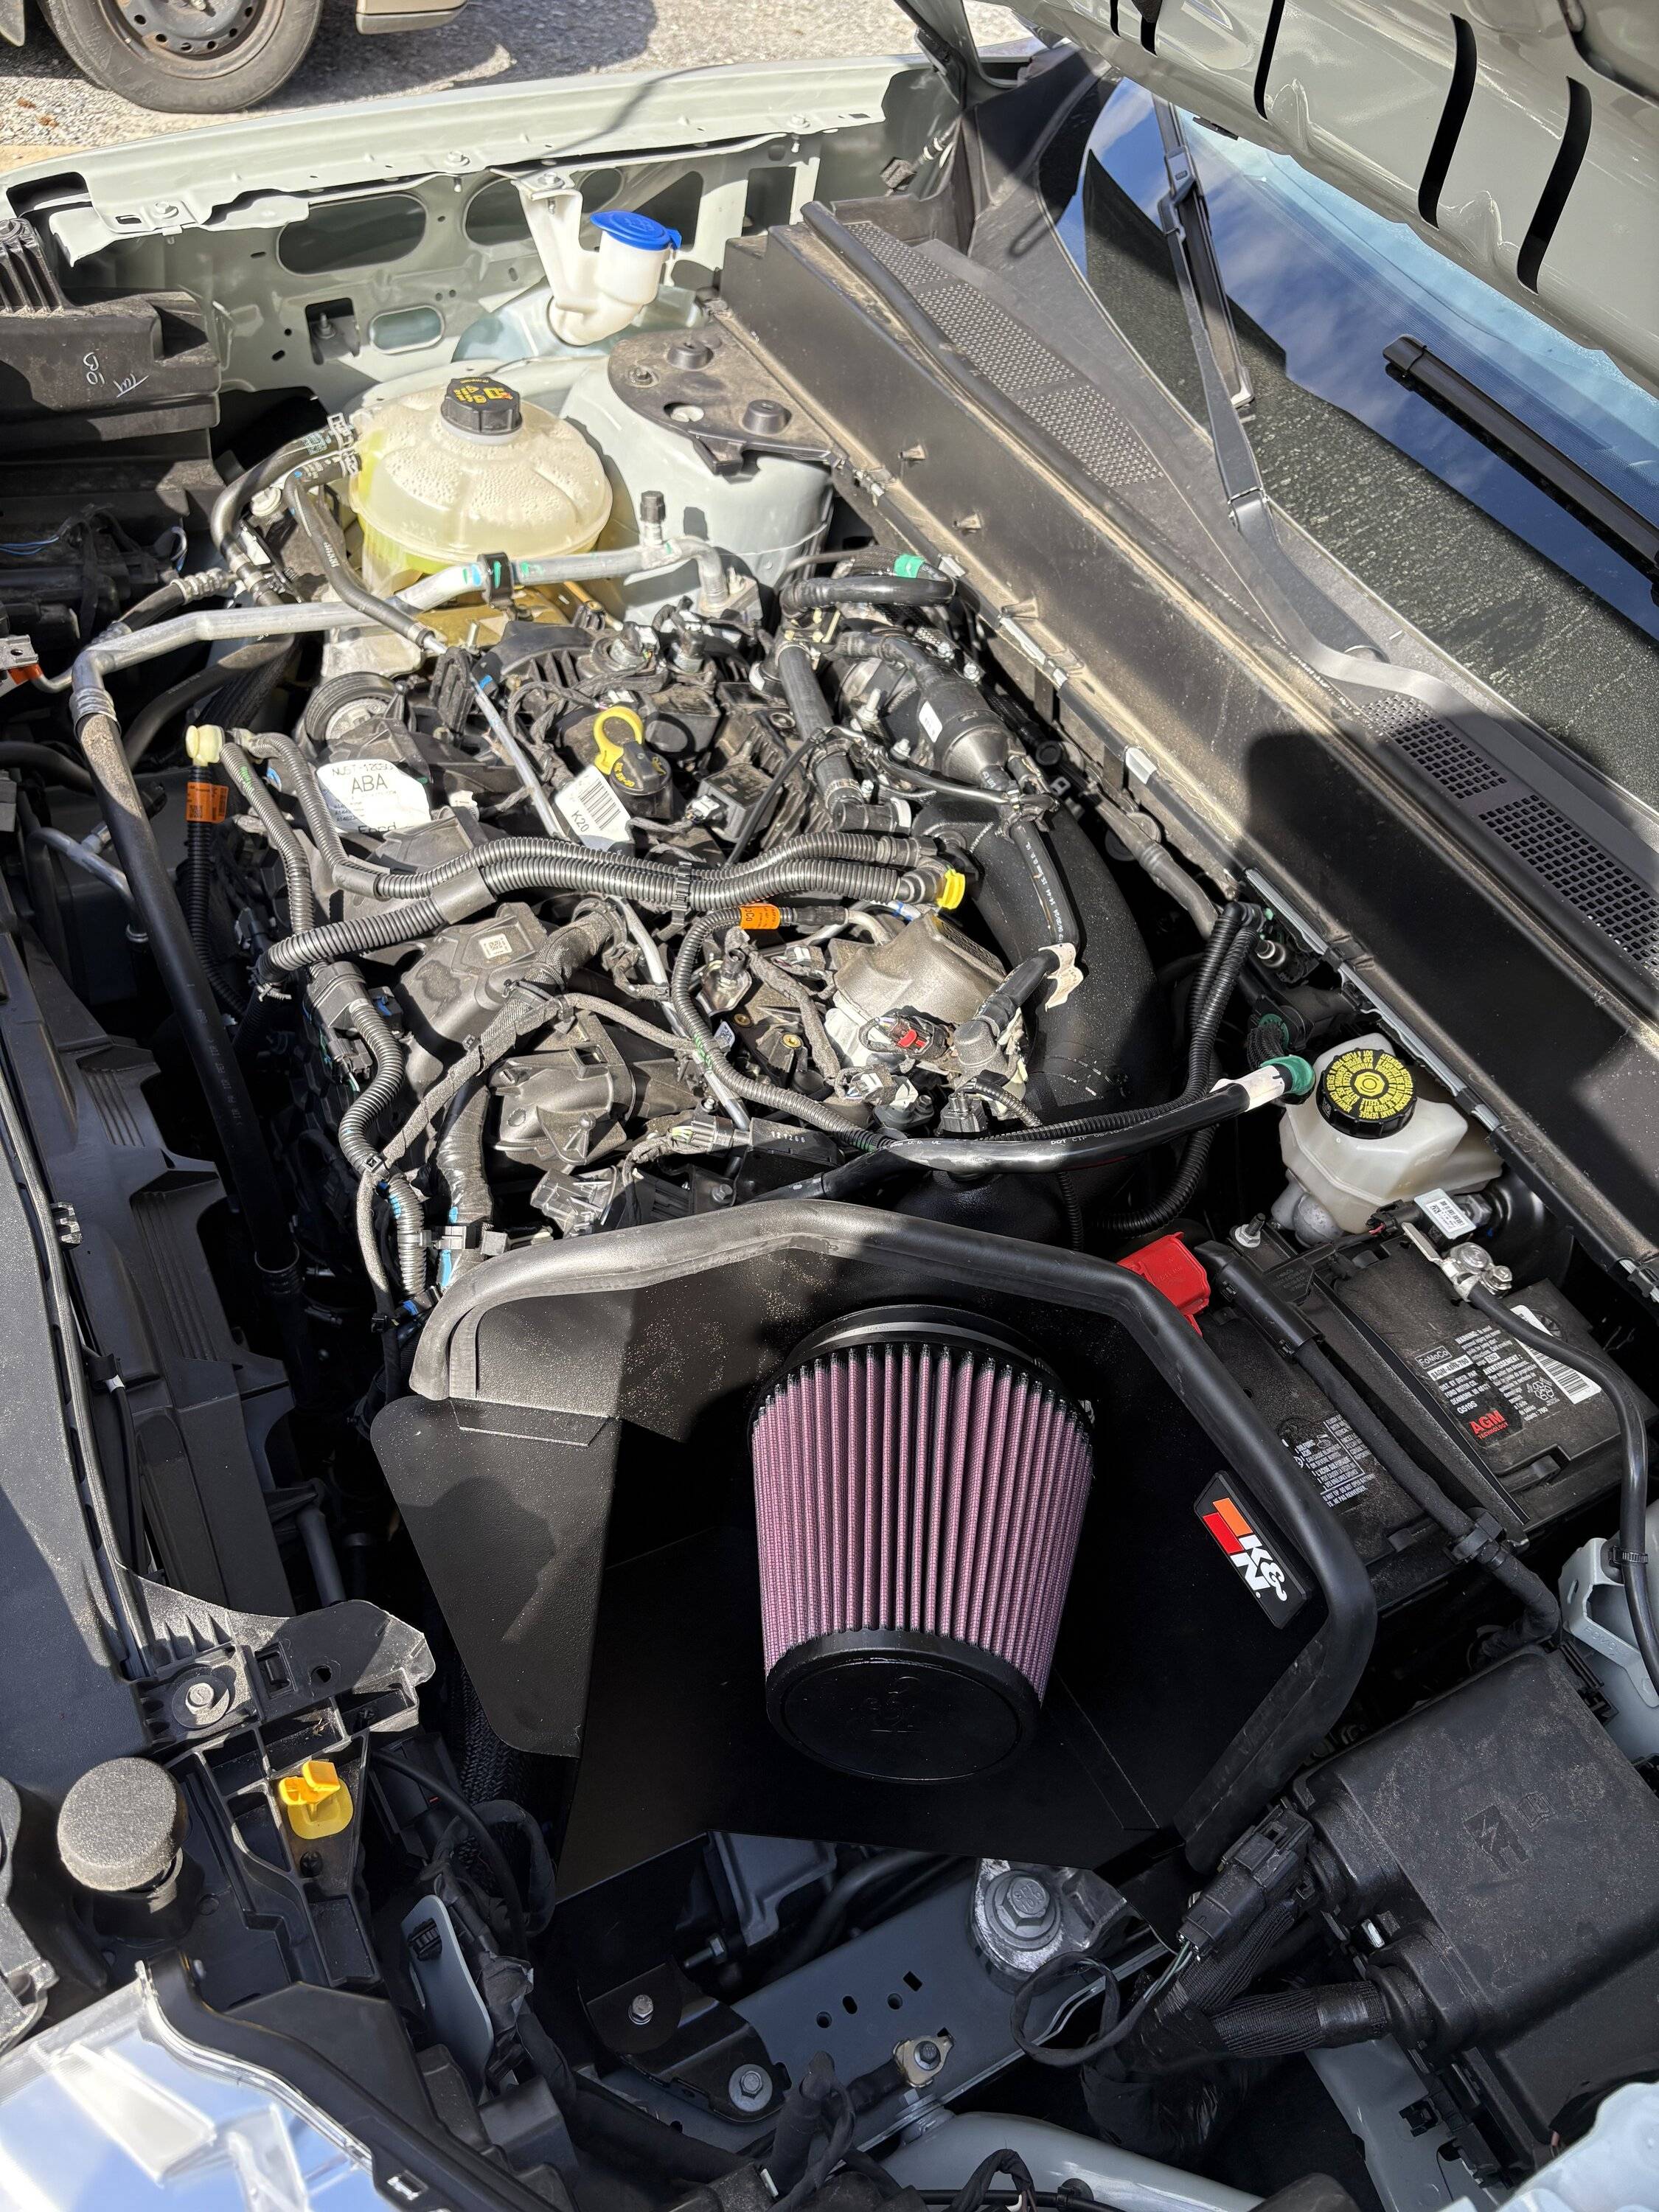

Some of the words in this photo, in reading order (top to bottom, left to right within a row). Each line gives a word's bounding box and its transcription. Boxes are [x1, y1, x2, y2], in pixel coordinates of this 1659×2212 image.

[351, 773, 389, 794] ABA
[571, 810, 590, 832] K20
[1359, 1110, 1380, 1119] DEPOSE
[1380, 1107, 1396, 1119] AVANT
[1418, 1349, 1449, 1366] FoMoCo
[1444, 1389, 1457, 1399] FORD
[1455, 1383, 1471, 1394] MOTOR
[1456, 1401, 1478, 1414] G519S
[1469, 1410, 1506, 1435] AGM
[1477, 1422, 1509, 1440] TECHNOLOGY
[1230, 1534, 1287, 1601] K&N
